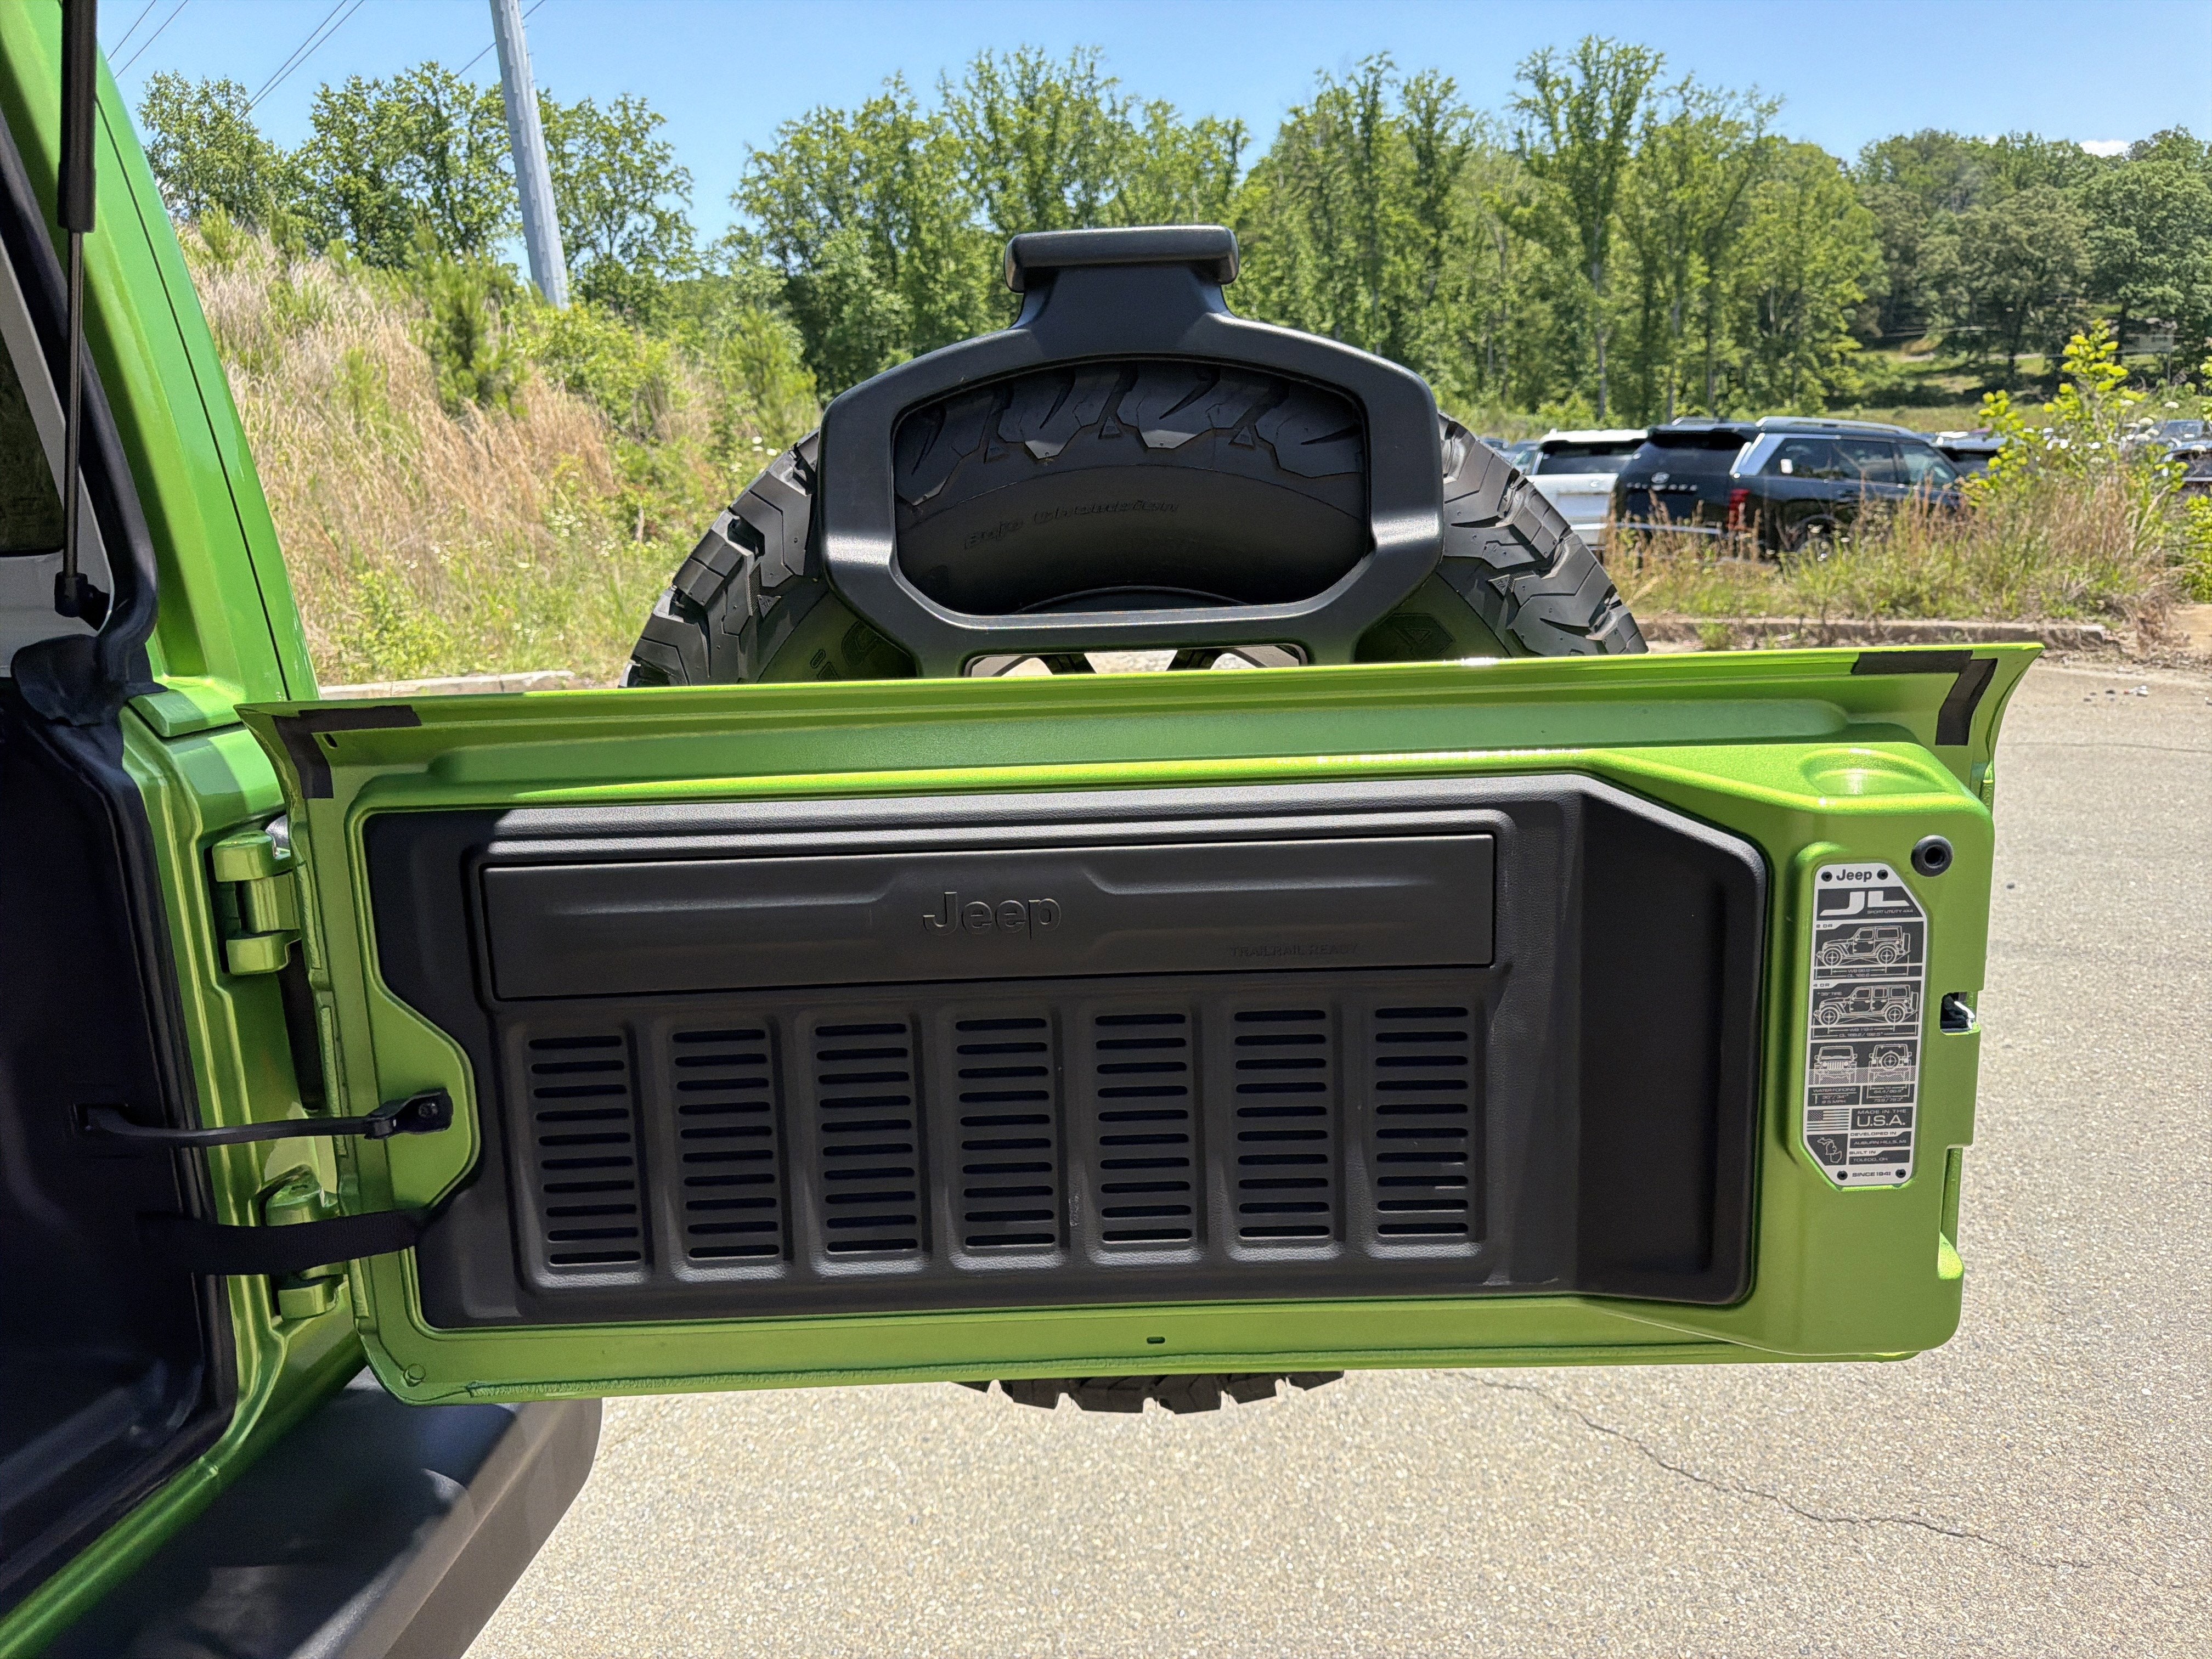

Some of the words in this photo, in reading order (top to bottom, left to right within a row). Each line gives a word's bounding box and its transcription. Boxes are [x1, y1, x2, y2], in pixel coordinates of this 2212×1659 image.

[1836, 869, 1872, 883] Jeep
[1820, 890, 1910, 916] JL
[923, 891, 1062, 939] Jeep
[1857, 1114, 1906, 1127] U.S.A.
